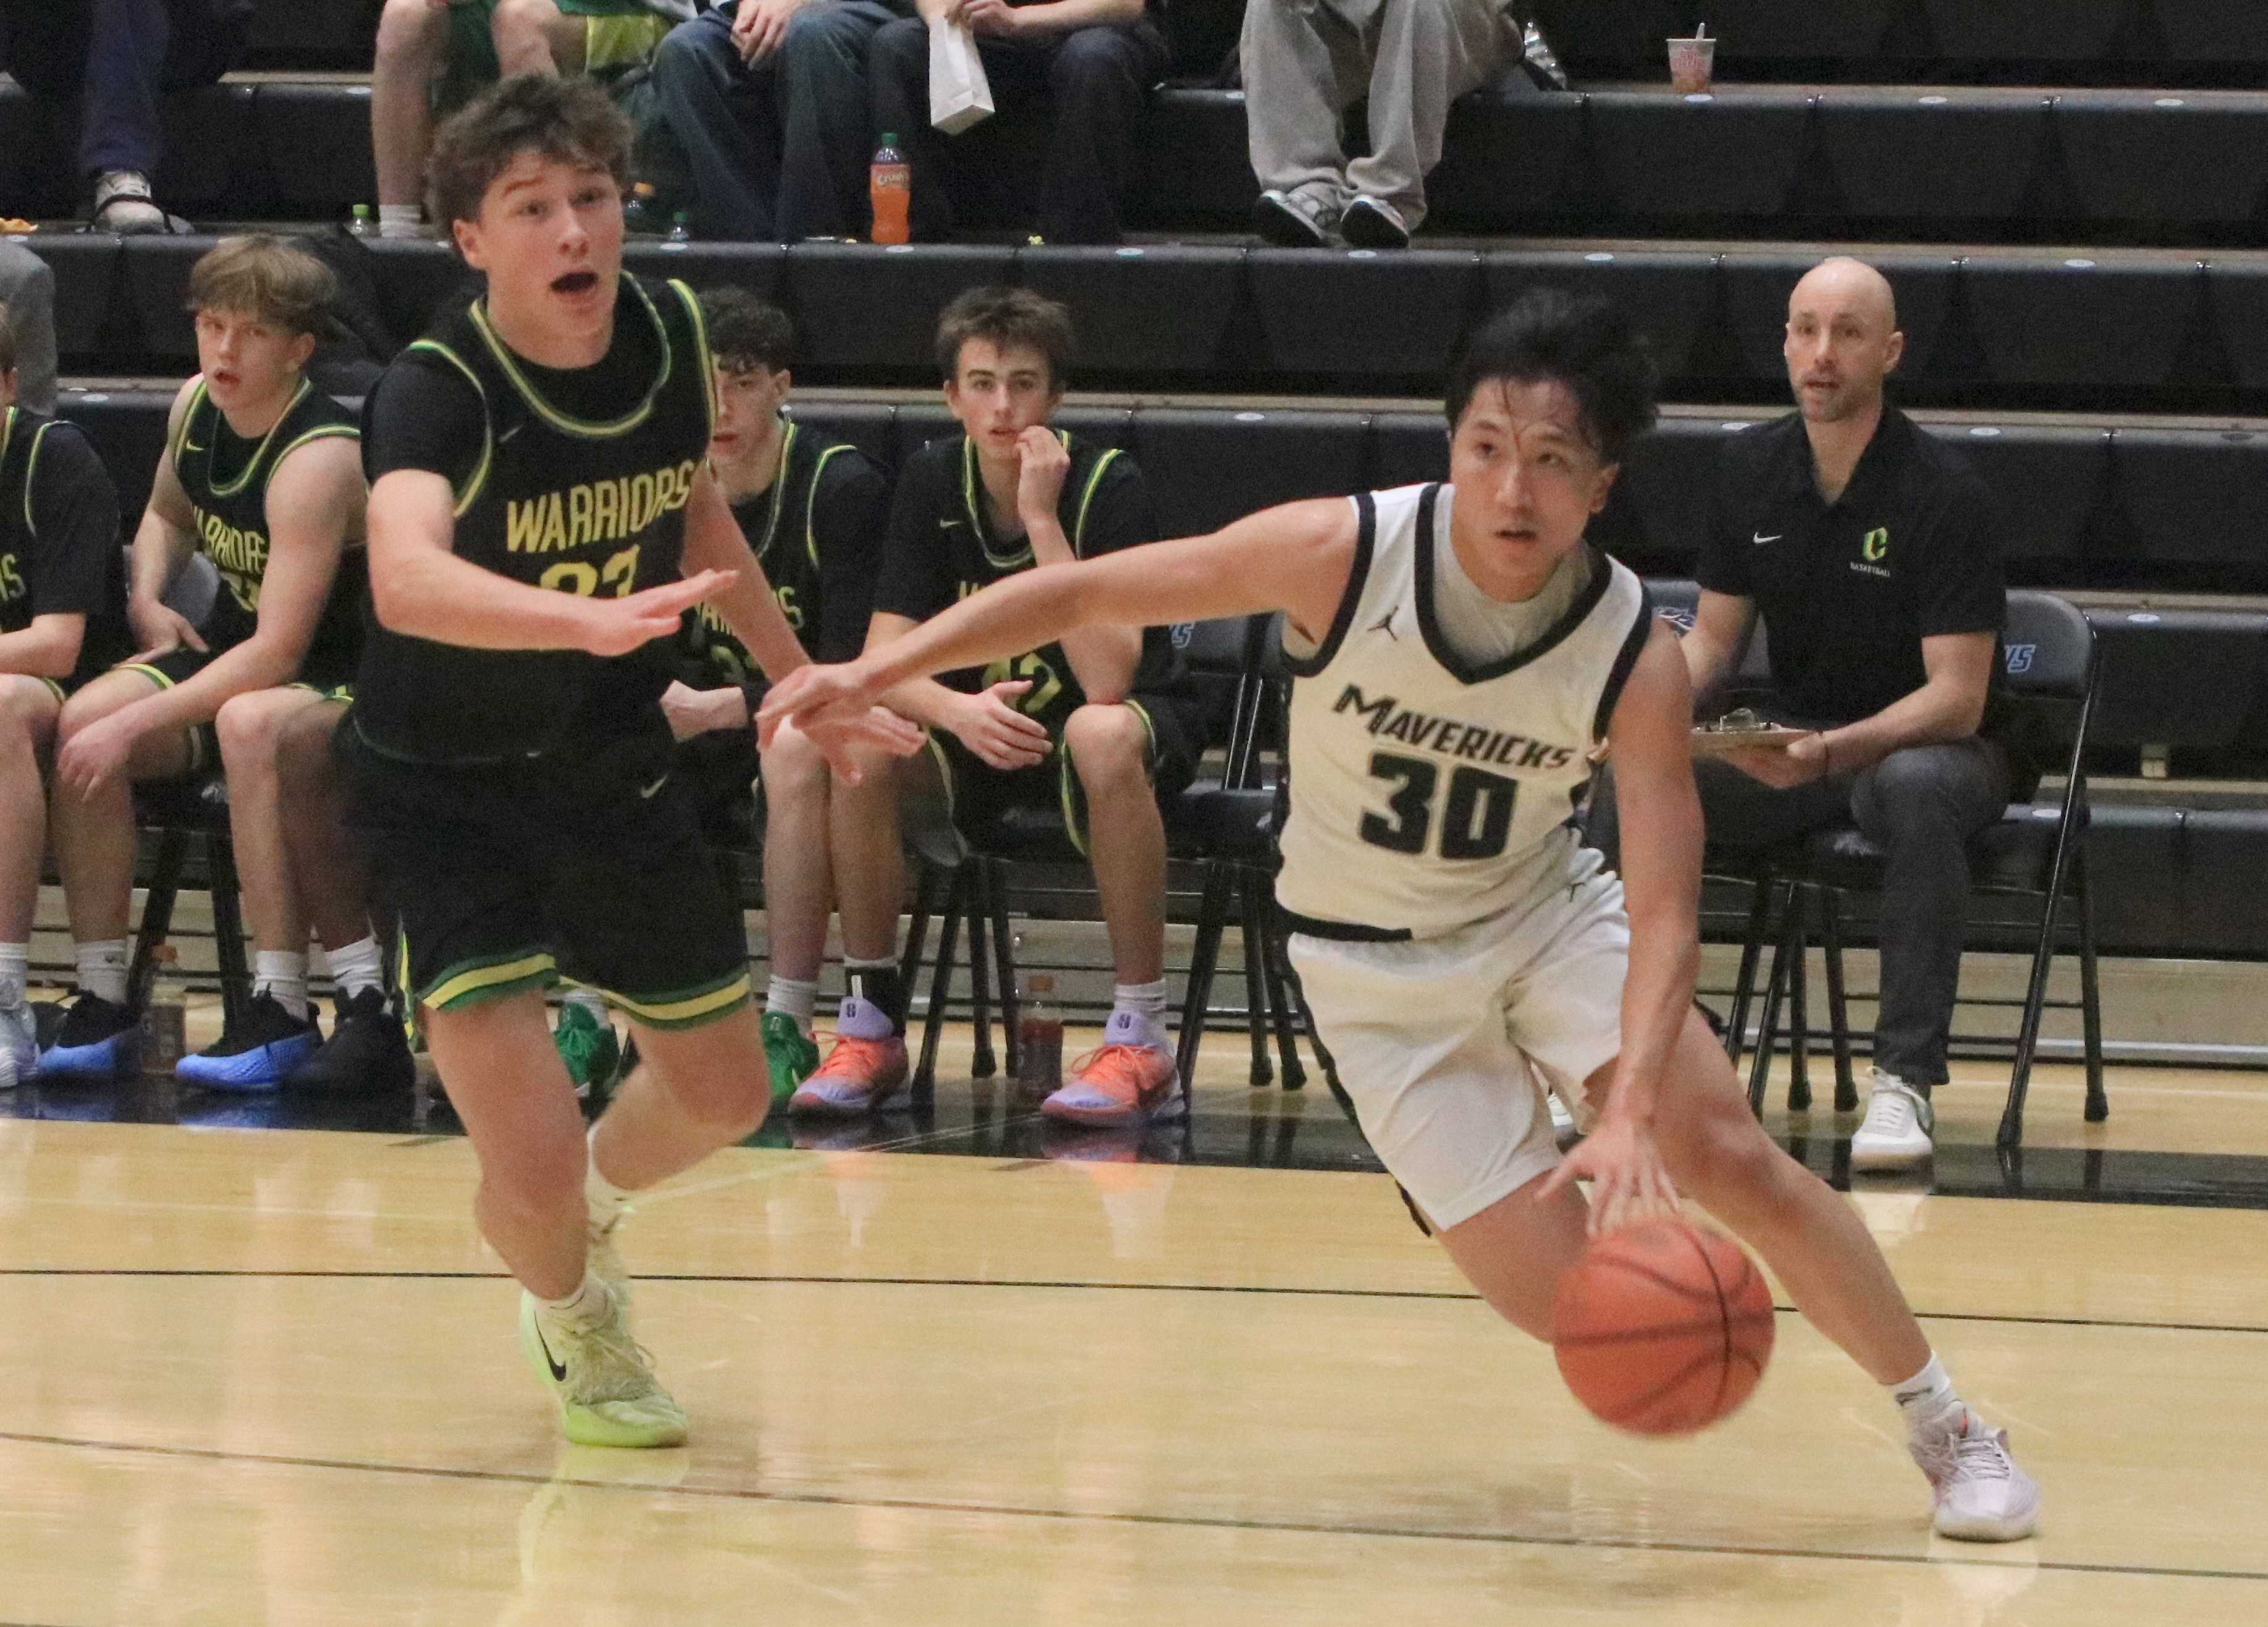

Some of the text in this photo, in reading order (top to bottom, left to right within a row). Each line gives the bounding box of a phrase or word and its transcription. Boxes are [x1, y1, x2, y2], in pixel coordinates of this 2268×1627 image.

[507, 460, 692, 554] WARRIORS
[1862, 527, 1889, 561] C
[1333, 683, 1577, 769] MAVERICKS
[1360, 752, 1519, 860] 30
